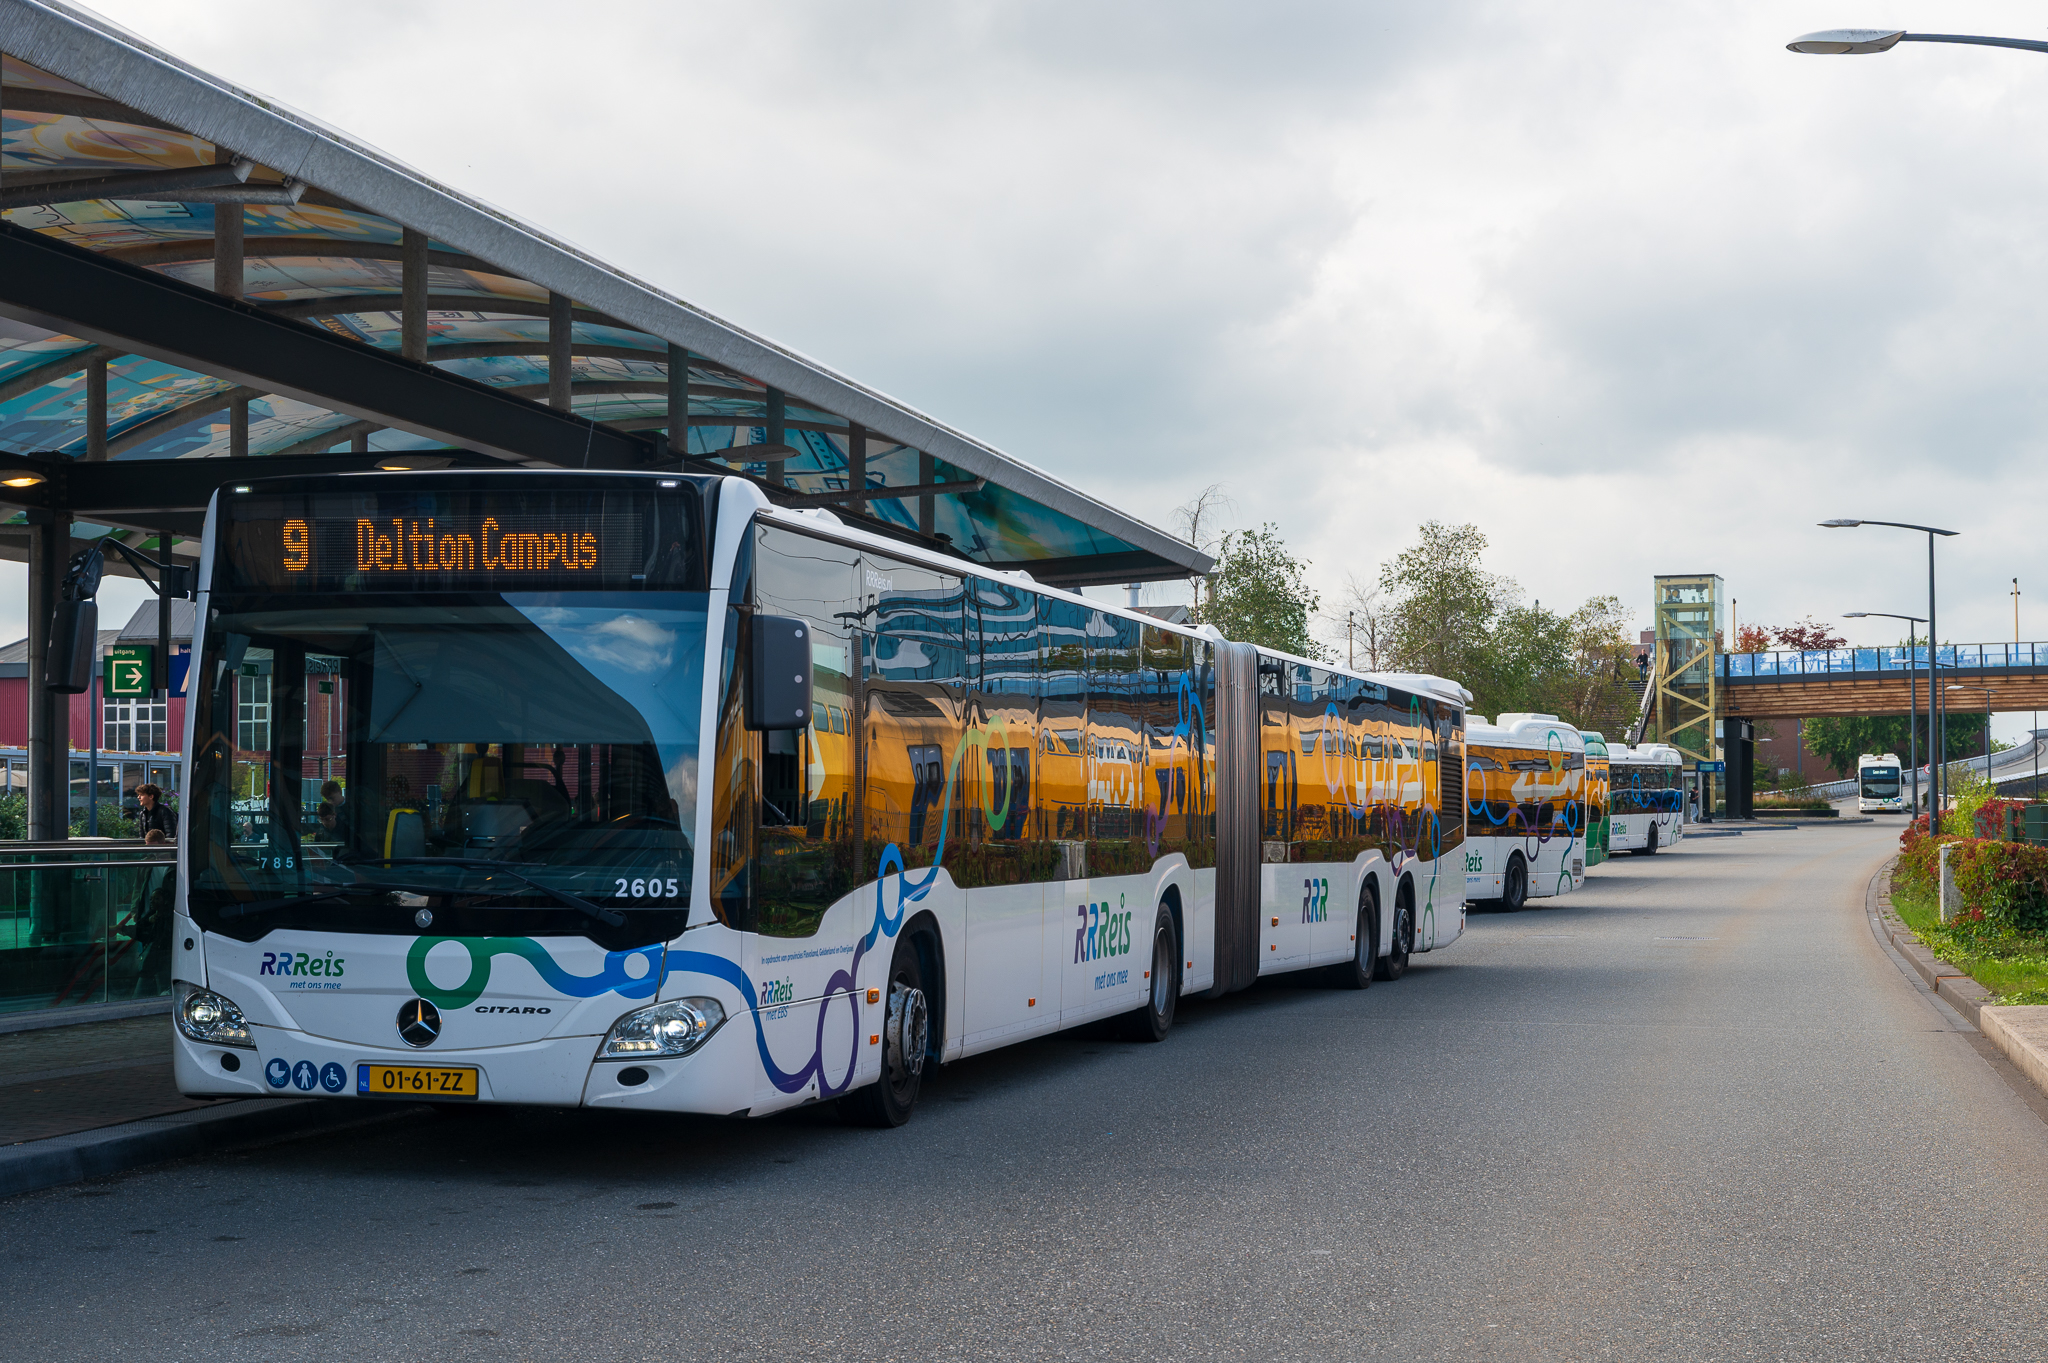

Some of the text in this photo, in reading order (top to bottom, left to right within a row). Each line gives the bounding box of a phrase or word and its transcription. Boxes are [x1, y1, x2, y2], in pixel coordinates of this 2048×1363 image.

[283, 517, 598, 571] 9 Deltion Campus
[866, 569, 893, 592] RRReis.nl
[114, 648, 136, 656] uitgang
[615, 878, 679, 898] 2605
[1302, 877, 1329, 924] RRR
[1074, 892, 1132, 964] RRReis
[260, 950, 345, 977] RRReis
[290, 980, 306, 989] met
[323, 982, 342, 990] mee
[760, 976, 793, 1005] RRReis
[1094, 969, 1128, 991] met ons mee
[475, 1006, 552, 1014] CITARO
[766, 1004, 789, 1021] met EBS
[382, 1070, 464, 1092] 01-61-ZZ
